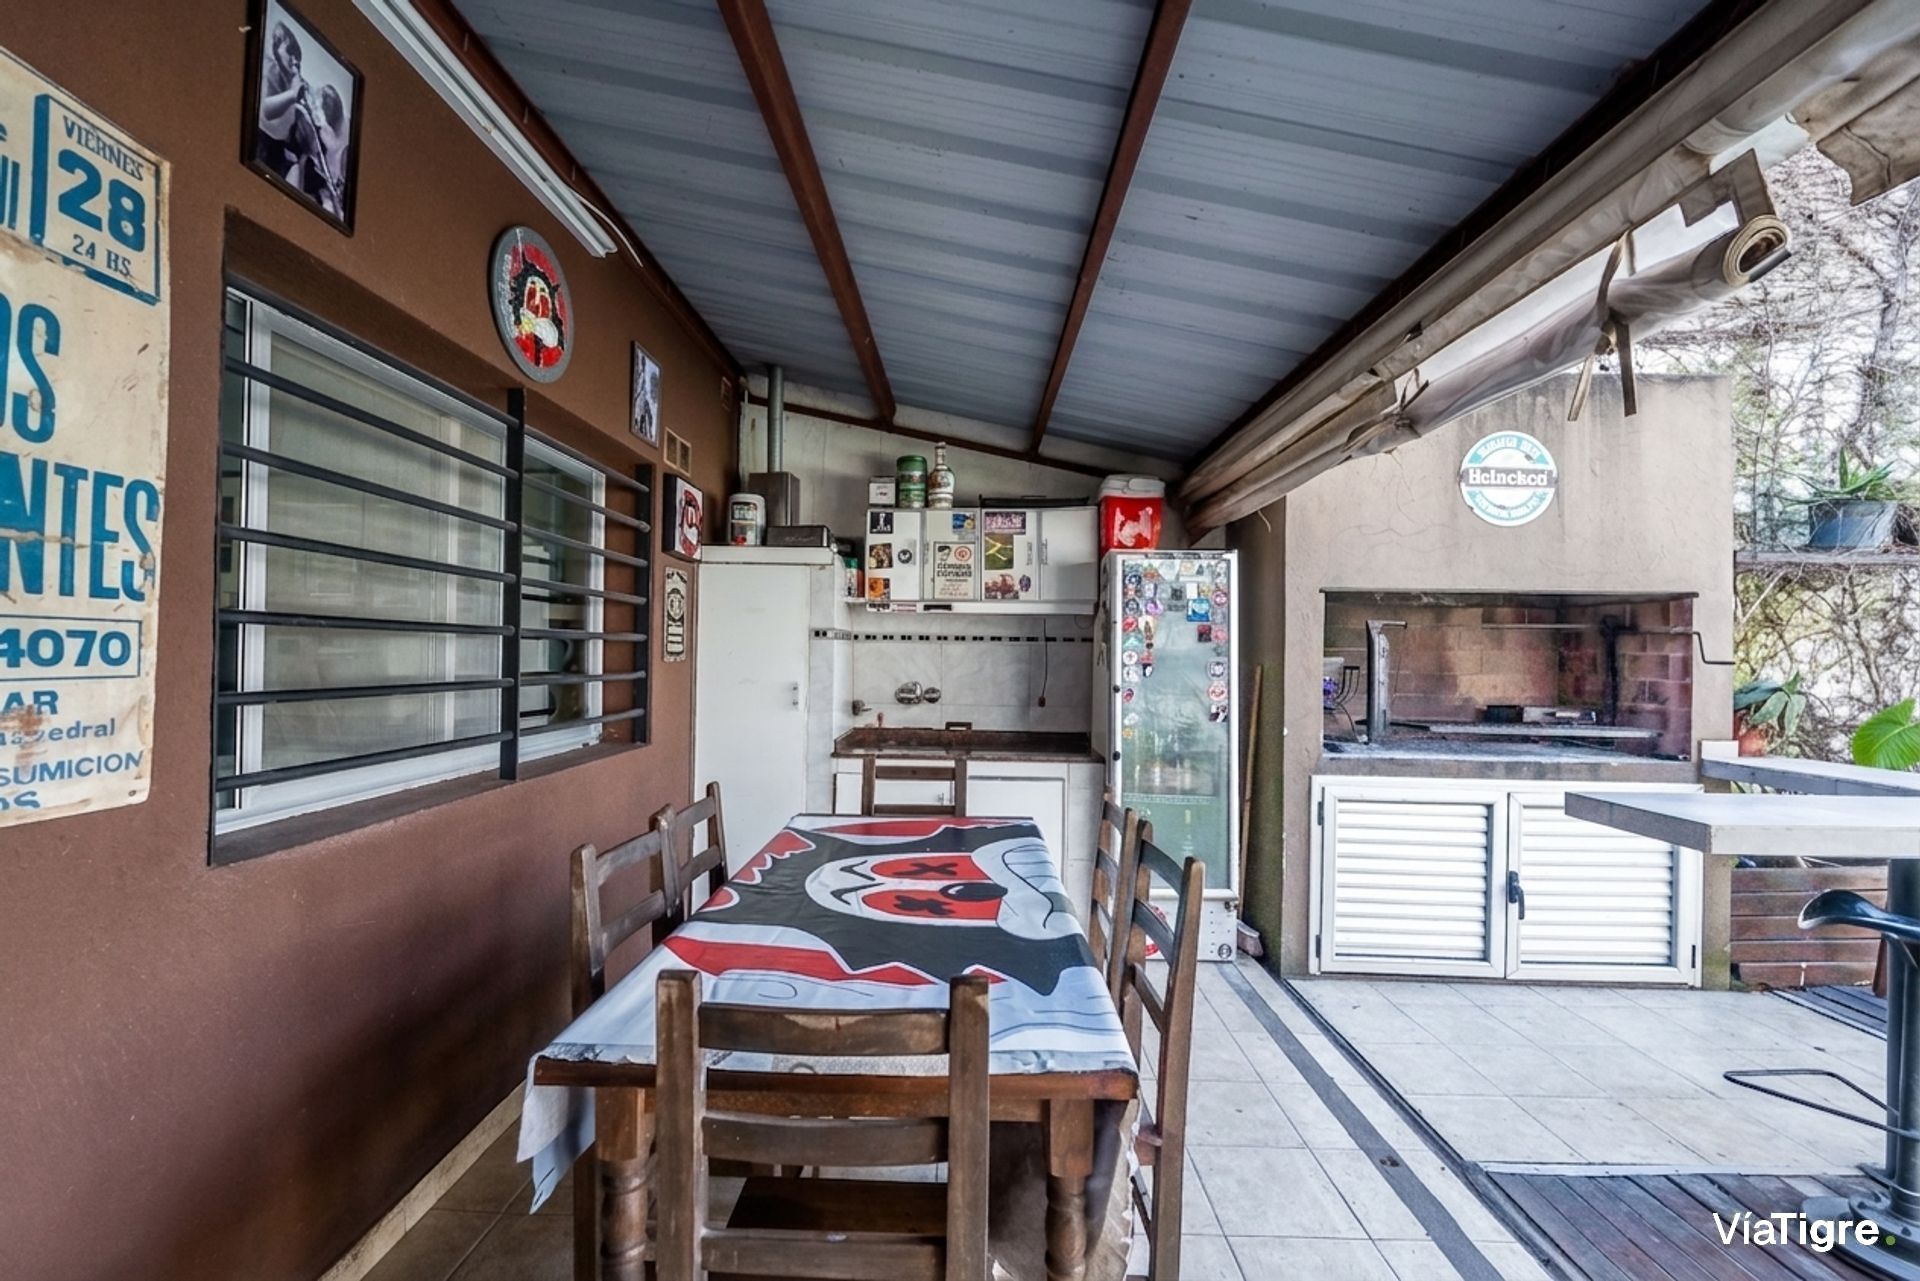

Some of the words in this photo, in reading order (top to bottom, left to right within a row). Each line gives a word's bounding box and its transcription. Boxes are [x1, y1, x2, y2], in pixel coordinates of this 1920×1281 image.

[63, 115, 144, 182] VIERNES
[58, 149, 145, 252] 28
[73, 233, 97, 260] 24
[0, 293, 61, 443] S
[0, 628, 132, 668] 4070
[0, 751, 144, 788] SUMICION
